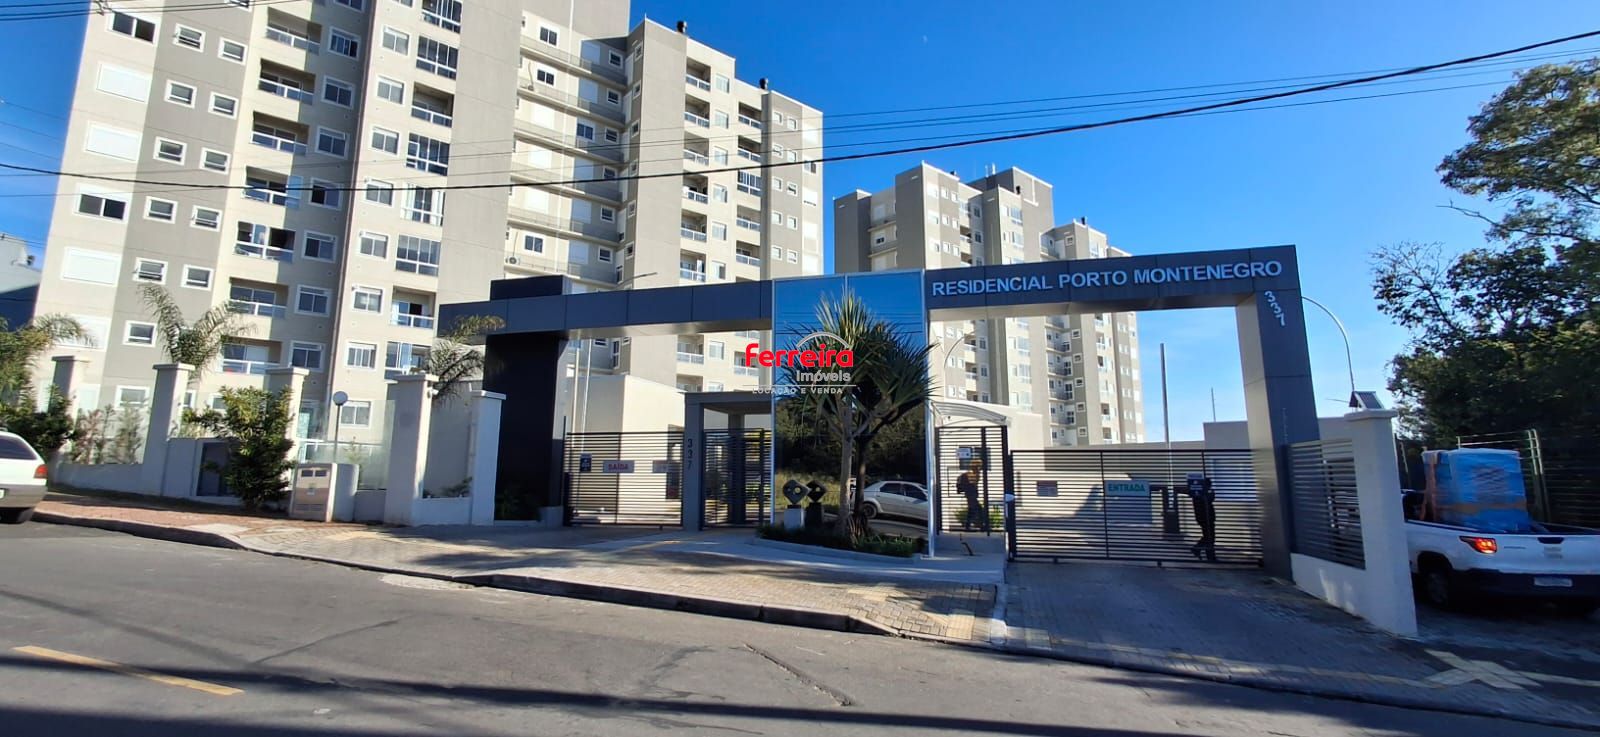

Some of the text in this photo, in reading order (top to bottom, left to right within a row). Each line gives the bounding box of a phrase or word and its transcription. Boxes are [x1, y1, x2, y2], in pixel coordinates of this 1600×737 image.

[932, 260, 1282, 297] RESIDENCIAL PORTO MONTENEGRO
[1264, 290, 1286, 326] 337
[1108, 482, 1146, 492] ENTRADA
